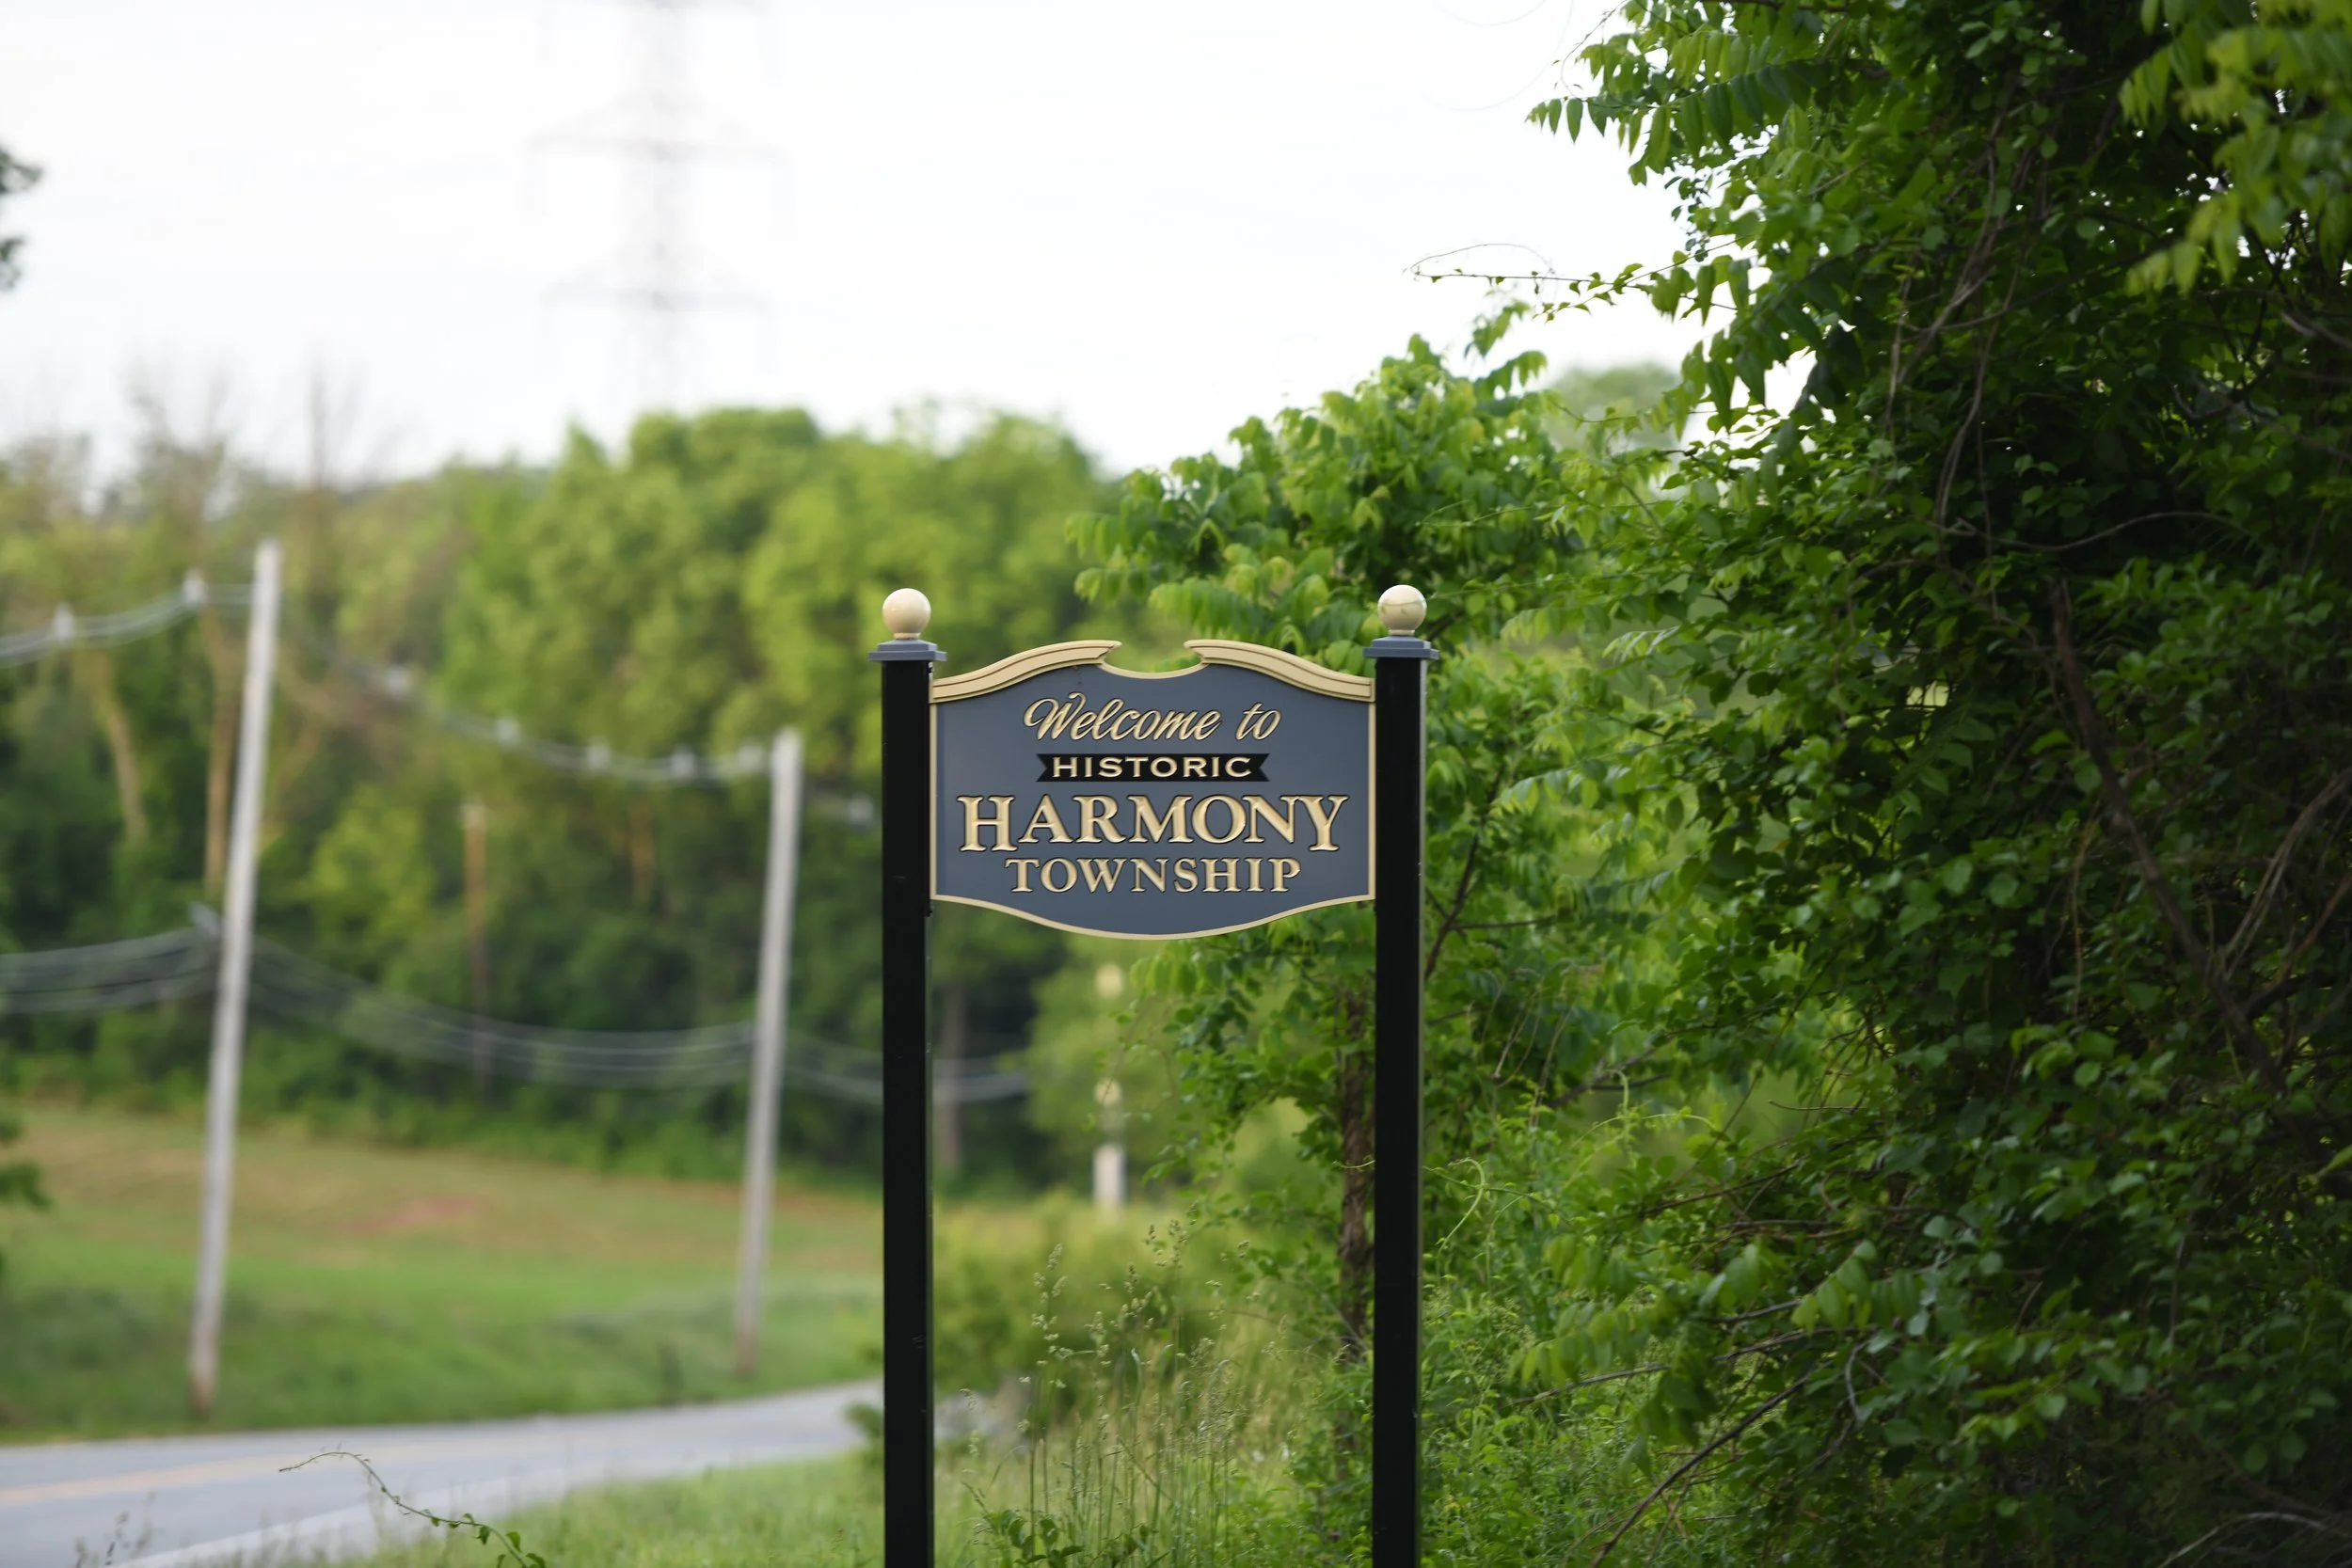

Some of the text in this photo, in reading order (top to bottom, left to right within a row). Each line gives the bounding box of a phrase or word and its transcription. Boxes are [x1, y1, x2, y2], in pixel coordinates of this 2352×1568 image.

[1024, 691, 1281, 740] Welcome to
[1052, 756, 1252, 778] HISTORIC
[957, 794, 1349, 851] HARMONY
[1005, 857, 1301, 893] TOWNSHIP
